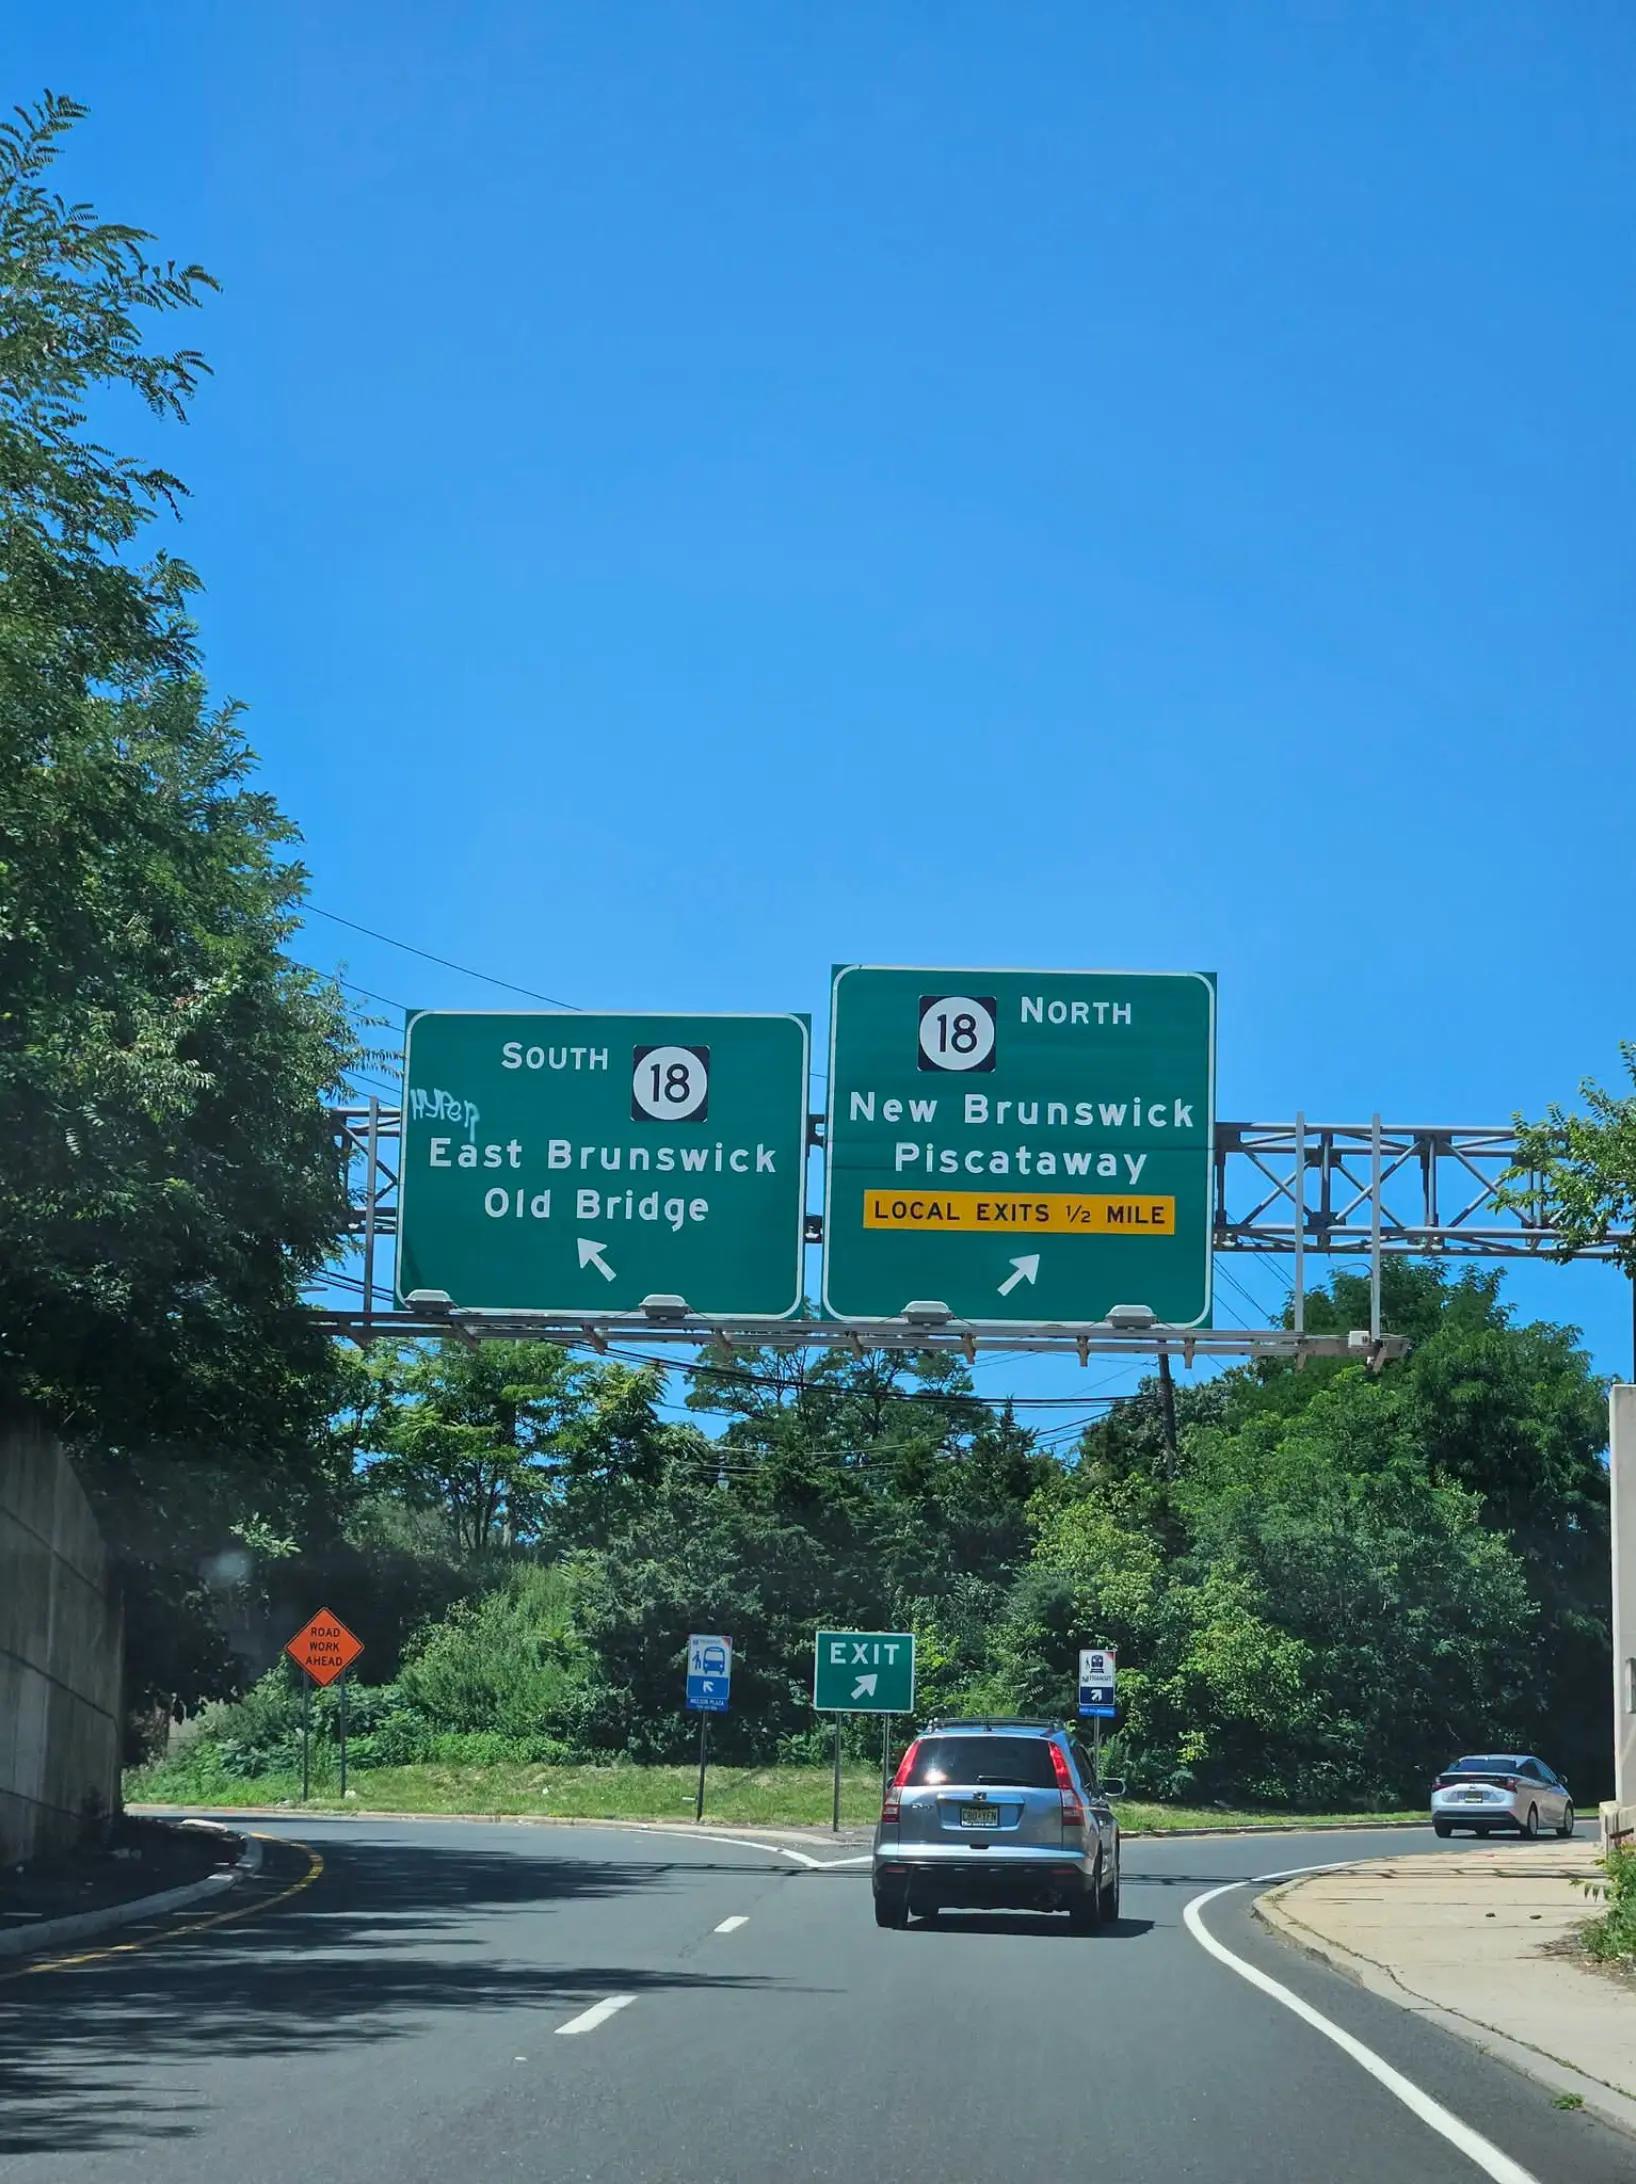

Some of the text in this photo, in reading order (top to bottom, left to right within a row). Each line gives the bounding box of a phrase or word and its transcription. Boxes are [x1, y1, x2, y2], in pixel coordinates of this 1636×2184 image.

[937, 996, 1132, 1053] 18 NORTH
[500, 1042, 690, 1103] SOUTH 18
[851, 1092, 1194, 1127] New Brunswick
[429, 1137, 776, 1173] East Brunswick
[894, 1142, 1148, 1184] Piscataway
[484, 1188, 709, 1232] Old Bridge
[874, 1201, 960, 1221] LOCAL
[976, 1203, 1049, 1222] EXITS
[1106, 1205, 1165, 1224] MILE
[309, 1641, 340, 1652] WORK
[311, 1627, 340, 1637] ROAD
[305, 1656, 343, 1666] AHEAD
[830, 1642, 900, 1665] EXIT
